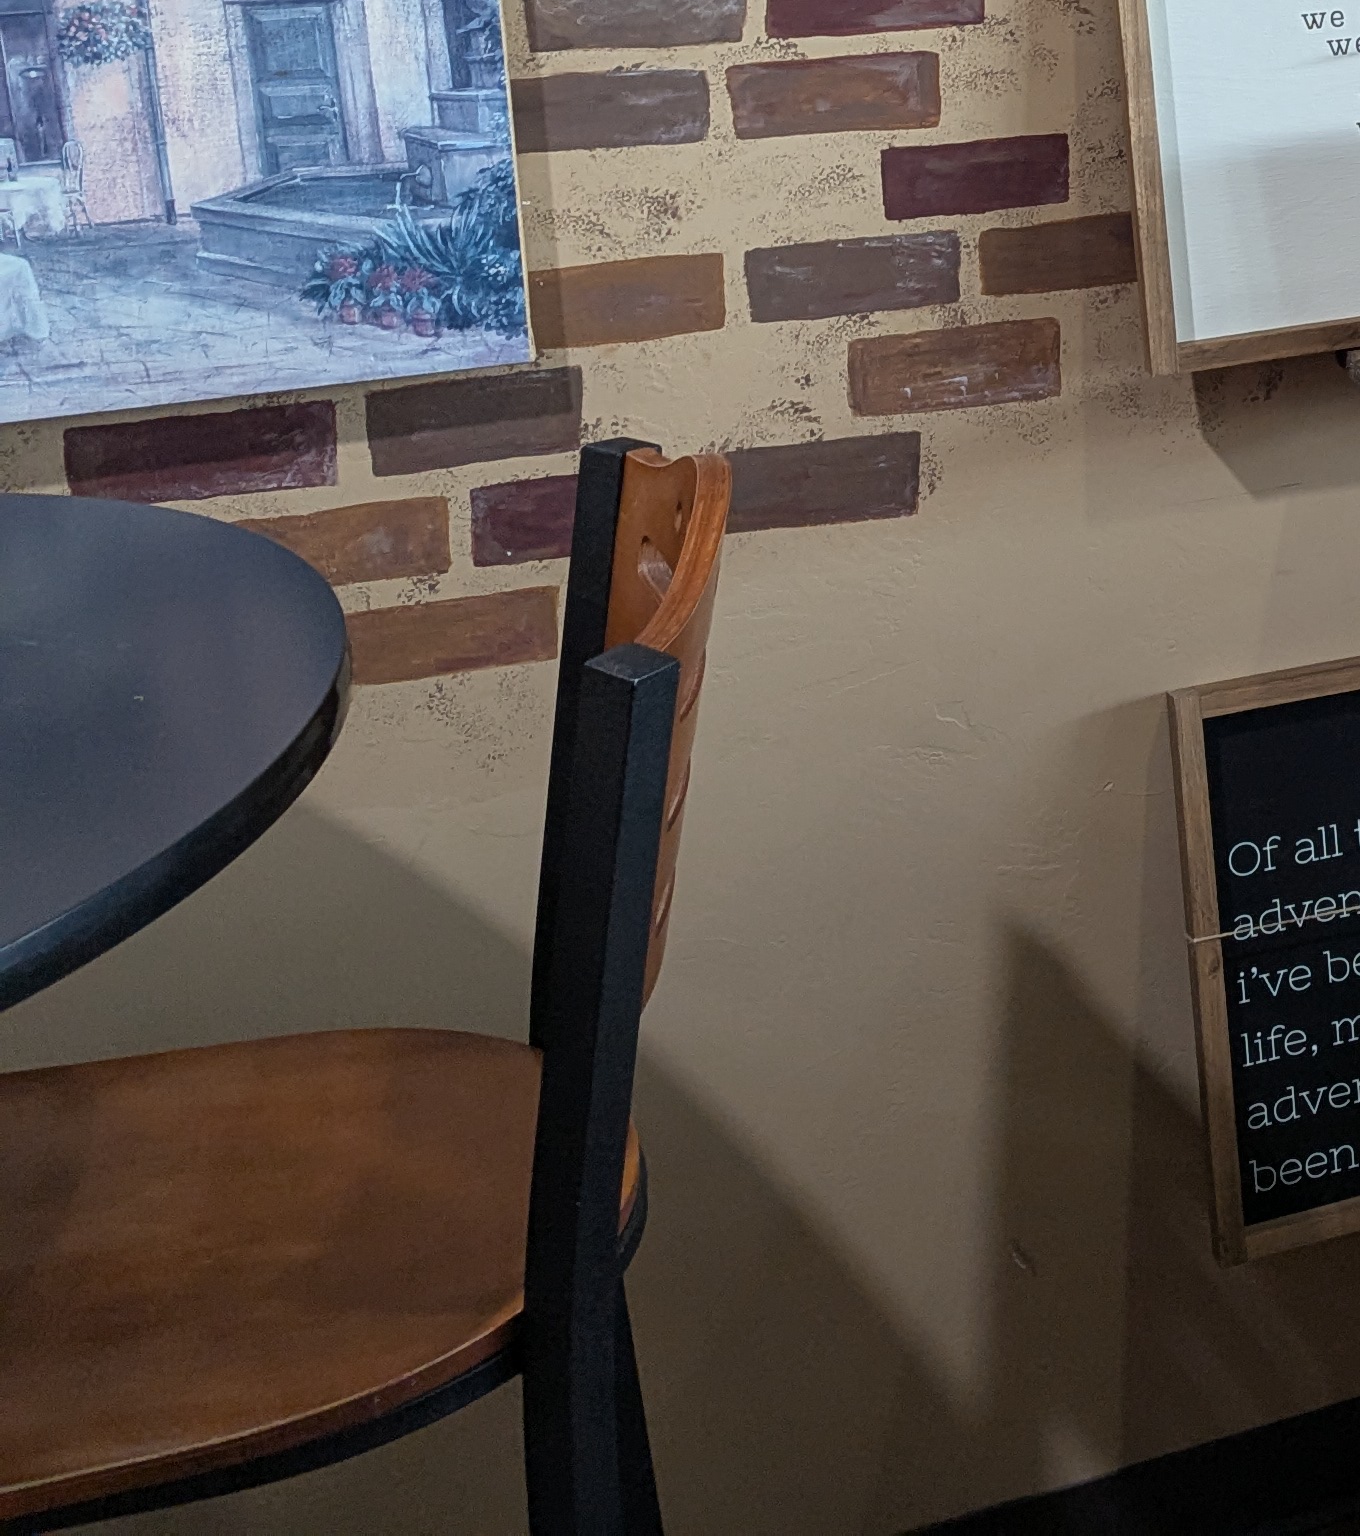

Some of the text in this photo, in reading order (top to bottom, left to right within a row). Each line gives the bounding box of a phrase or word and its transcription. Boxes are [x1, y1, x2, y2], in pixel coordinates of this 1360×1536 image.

[1229, 836, 1280, 876] Of
[1295, 824, 1343, 864] all
[1241, 1025, 1317, 1067] life,
